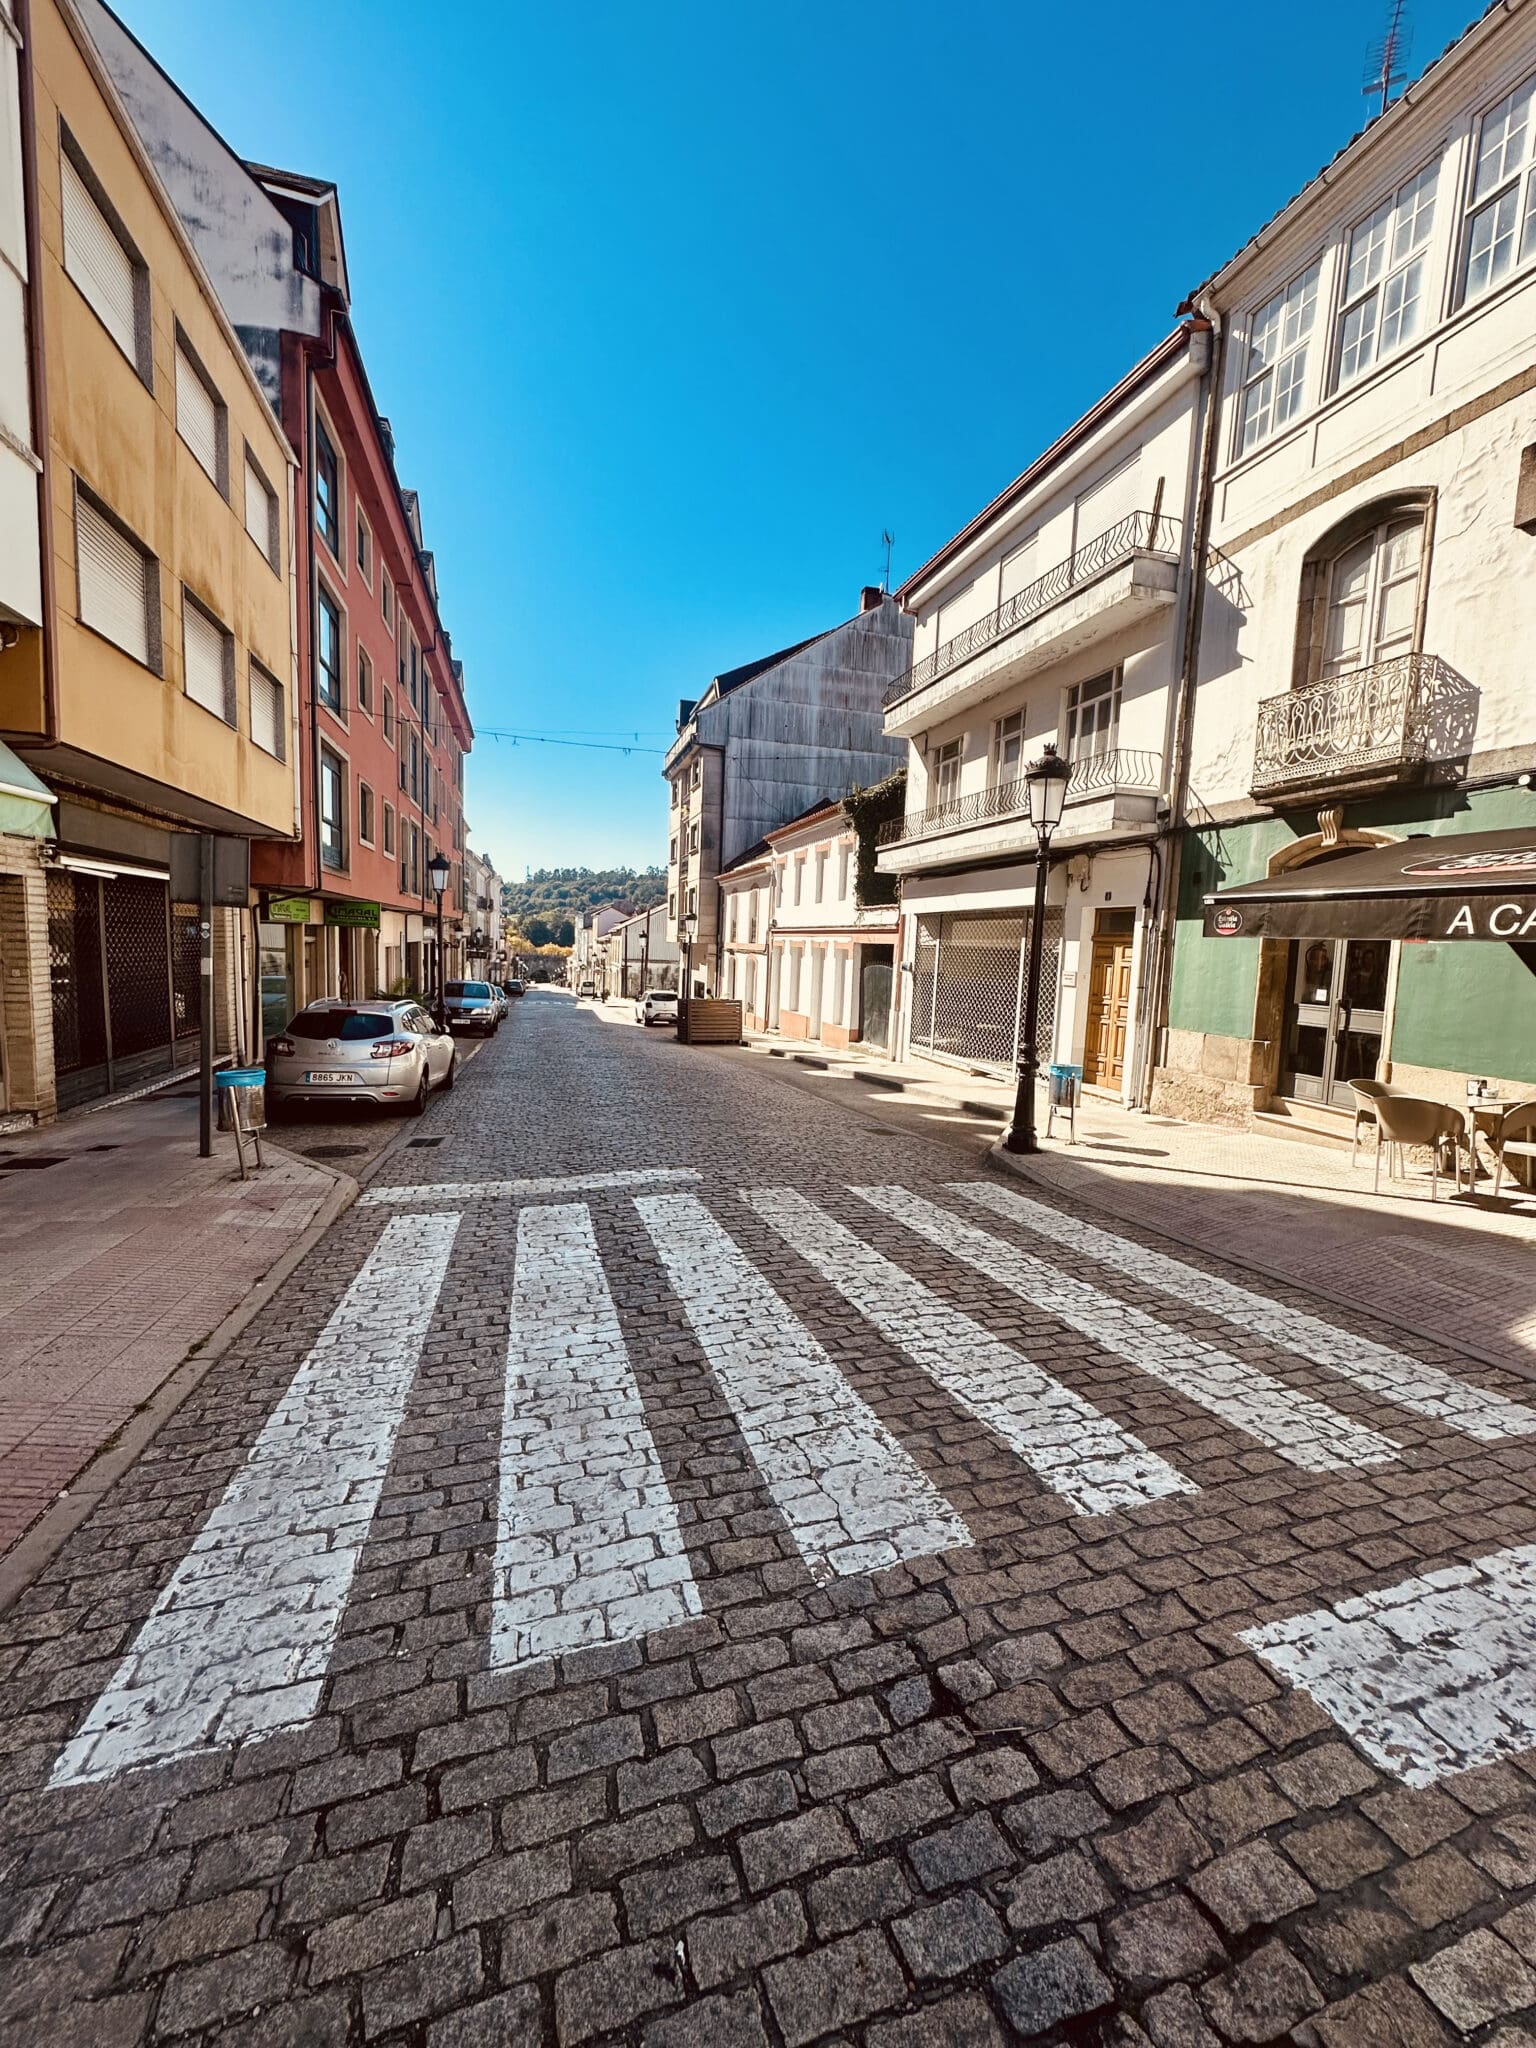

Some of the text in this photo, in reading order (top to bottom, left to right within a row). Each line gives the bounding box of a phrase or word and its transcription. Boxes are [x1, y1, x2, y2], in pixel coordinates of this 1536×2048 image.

[1446, 905, 1475, 935] A
[312, 1073, 353, 1082] 8865 JKN
